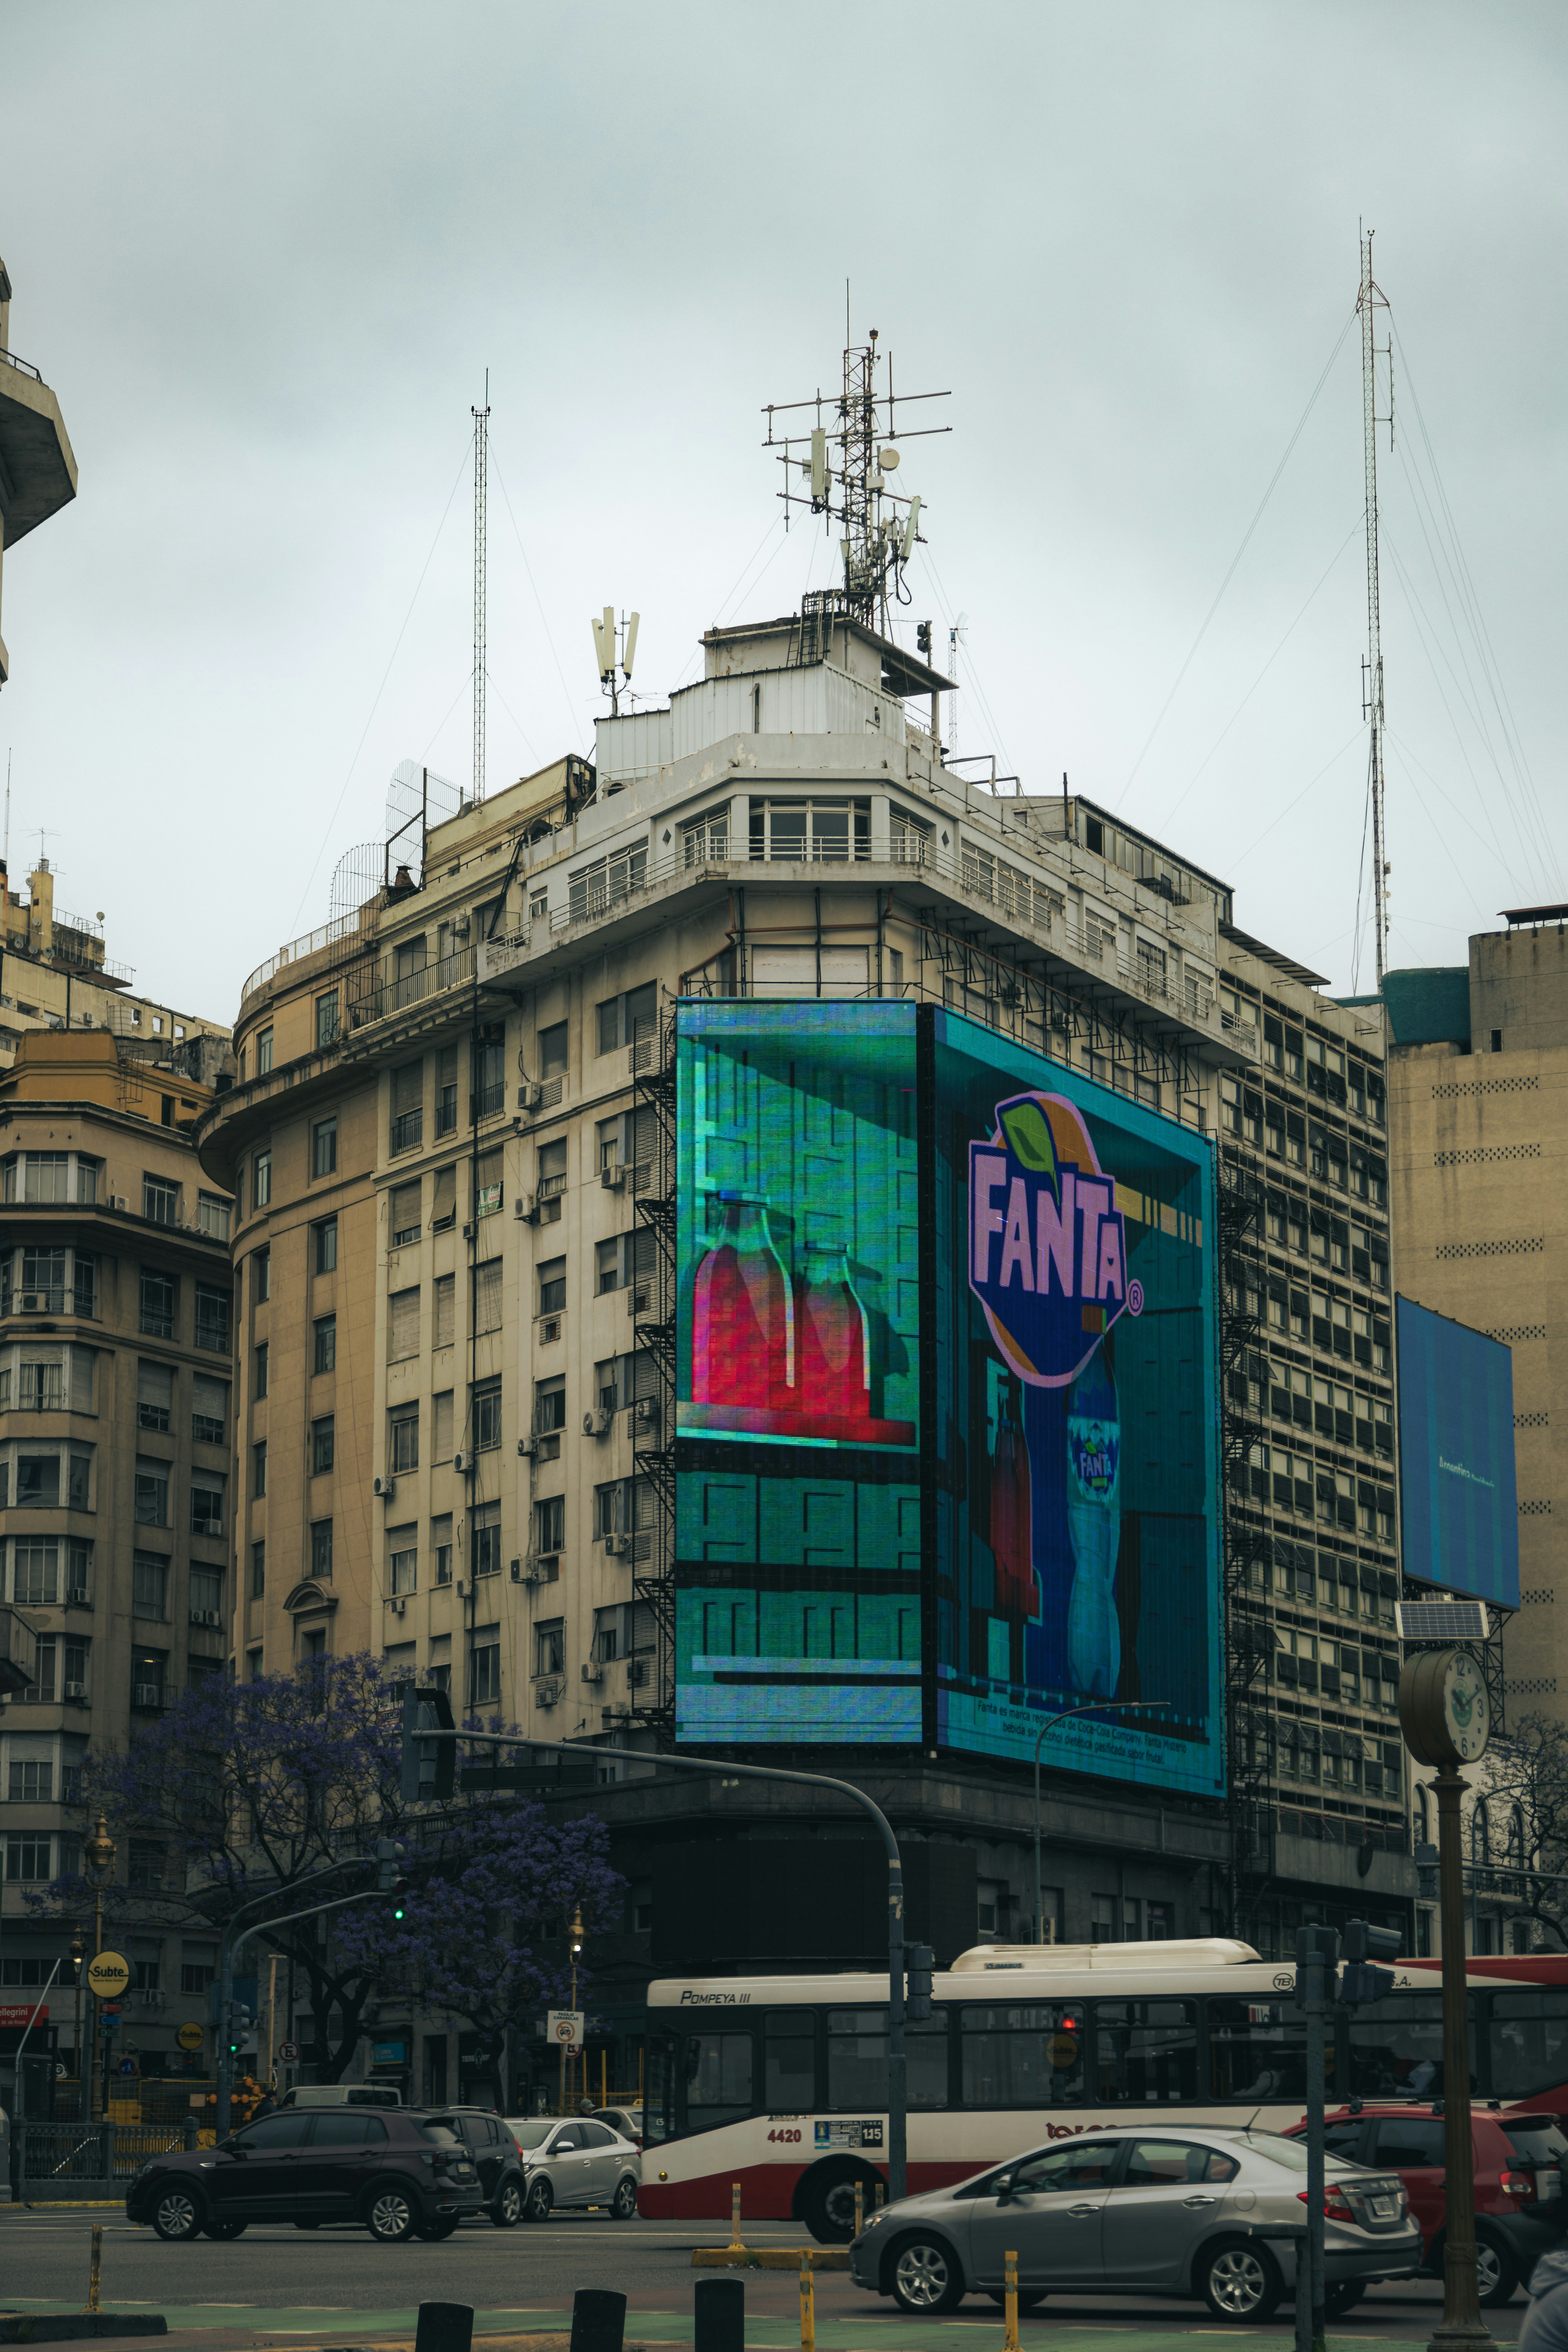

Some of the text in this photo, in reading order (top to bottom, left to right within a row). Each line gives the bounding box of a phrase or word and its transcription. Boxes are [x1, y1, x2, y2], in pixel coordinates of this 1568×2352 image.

[974, 1153, 1123, 1300] FANTA
[1455, 1658, 1465, 1676] 12
[1478, 1698, 1484, 1718] 3
[978, 1700, 997, 1714] Fanta
[1000, 1707, 1007, 1717] es
[1010, 1710, 1030, 1721] marca
[1068, 1720, 1075, 1731] de
[1078, 1721, 1110, 1738] Coca-Cola
[1145, 1734, 1161, 1748] Fanta
[1164, 1739, 1186, 1753] Misterio
[1003, 1721, 1025, 1735] bebida
[1028, 1727, 1037, 1737] sin
[1094, 1742, 1126, 1757] gasificada
[1127, 1749, 1144, 1760] sabor
[1462, 1737, 1468, 1757] 6
[91, 1966, 126, 1977] Subte
[739, 1993, 751, 2003] III
[767, 2129, 801, 2142] 4420
[863, 2129, 881, 2139] 115
